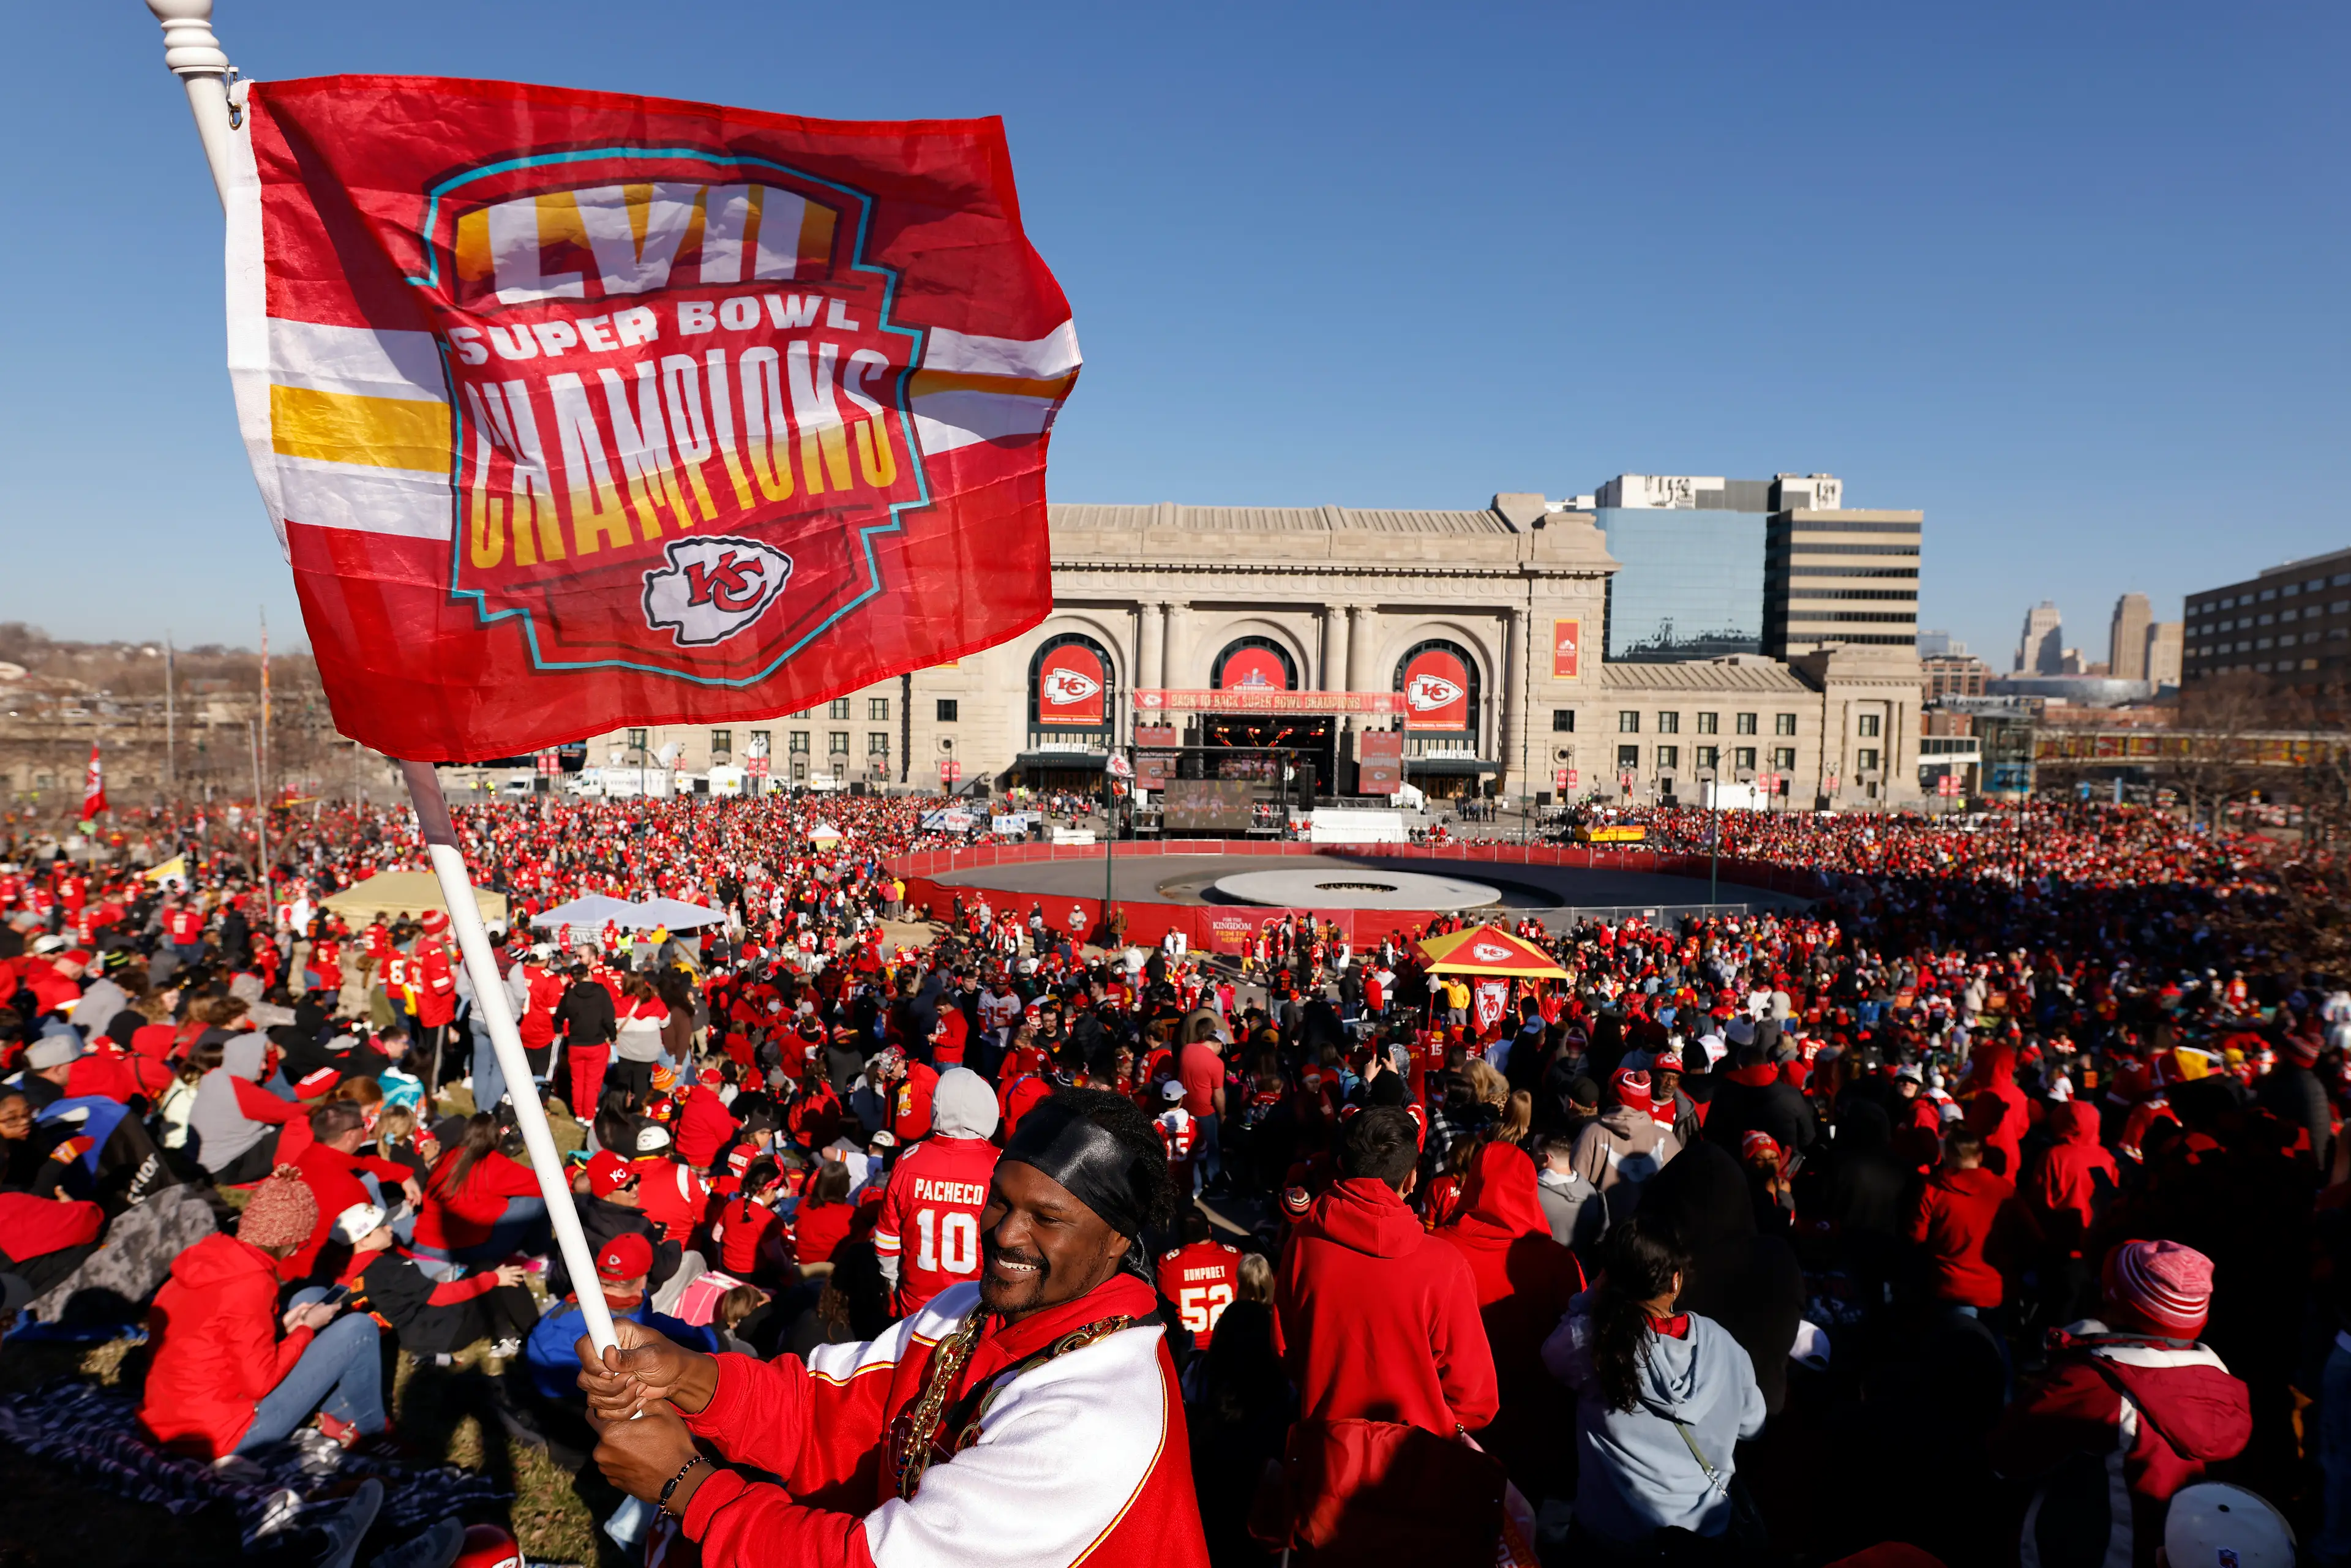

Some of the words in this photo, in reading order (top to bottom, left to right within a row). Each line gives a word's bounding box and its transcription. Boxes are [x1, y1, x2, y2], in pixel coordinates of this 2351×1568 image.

[448, 305, 659, 366] SUPER
[677, 294, 859, 337] BOWL
[465, 340, 897, 568] CHAMPIONS
[686, 550, 766, 612] KC
[1059, 678, 1086, 696] KC
[1422, 683, 1449, 701] KC
[1242, 695, 1272, 708] SUPER
[1274, 696, 1301, 708] BOWL
[1305, 696, 1360, 709] CHAMPIONS
[1040, 742, 1070, 753] KANSAS
[1071, 743, 1088, 754] CITY
[1427, 749, 1457, 759] KANSAS
[1458, 749, 1476, 760] CITY
[1213, 921, 1252, 930] KINGDOM
[1431, 1043, 1442, 1056] 15
[610, 1168, 626, 1183] KC
[915, 1178, 984, 1206] PACHECO
[917, 1208, 977, 1274] 10
[1183, 1266, 1225, 1281] HUMPHREY
[1180, 1283, 1233, 1333] 52
